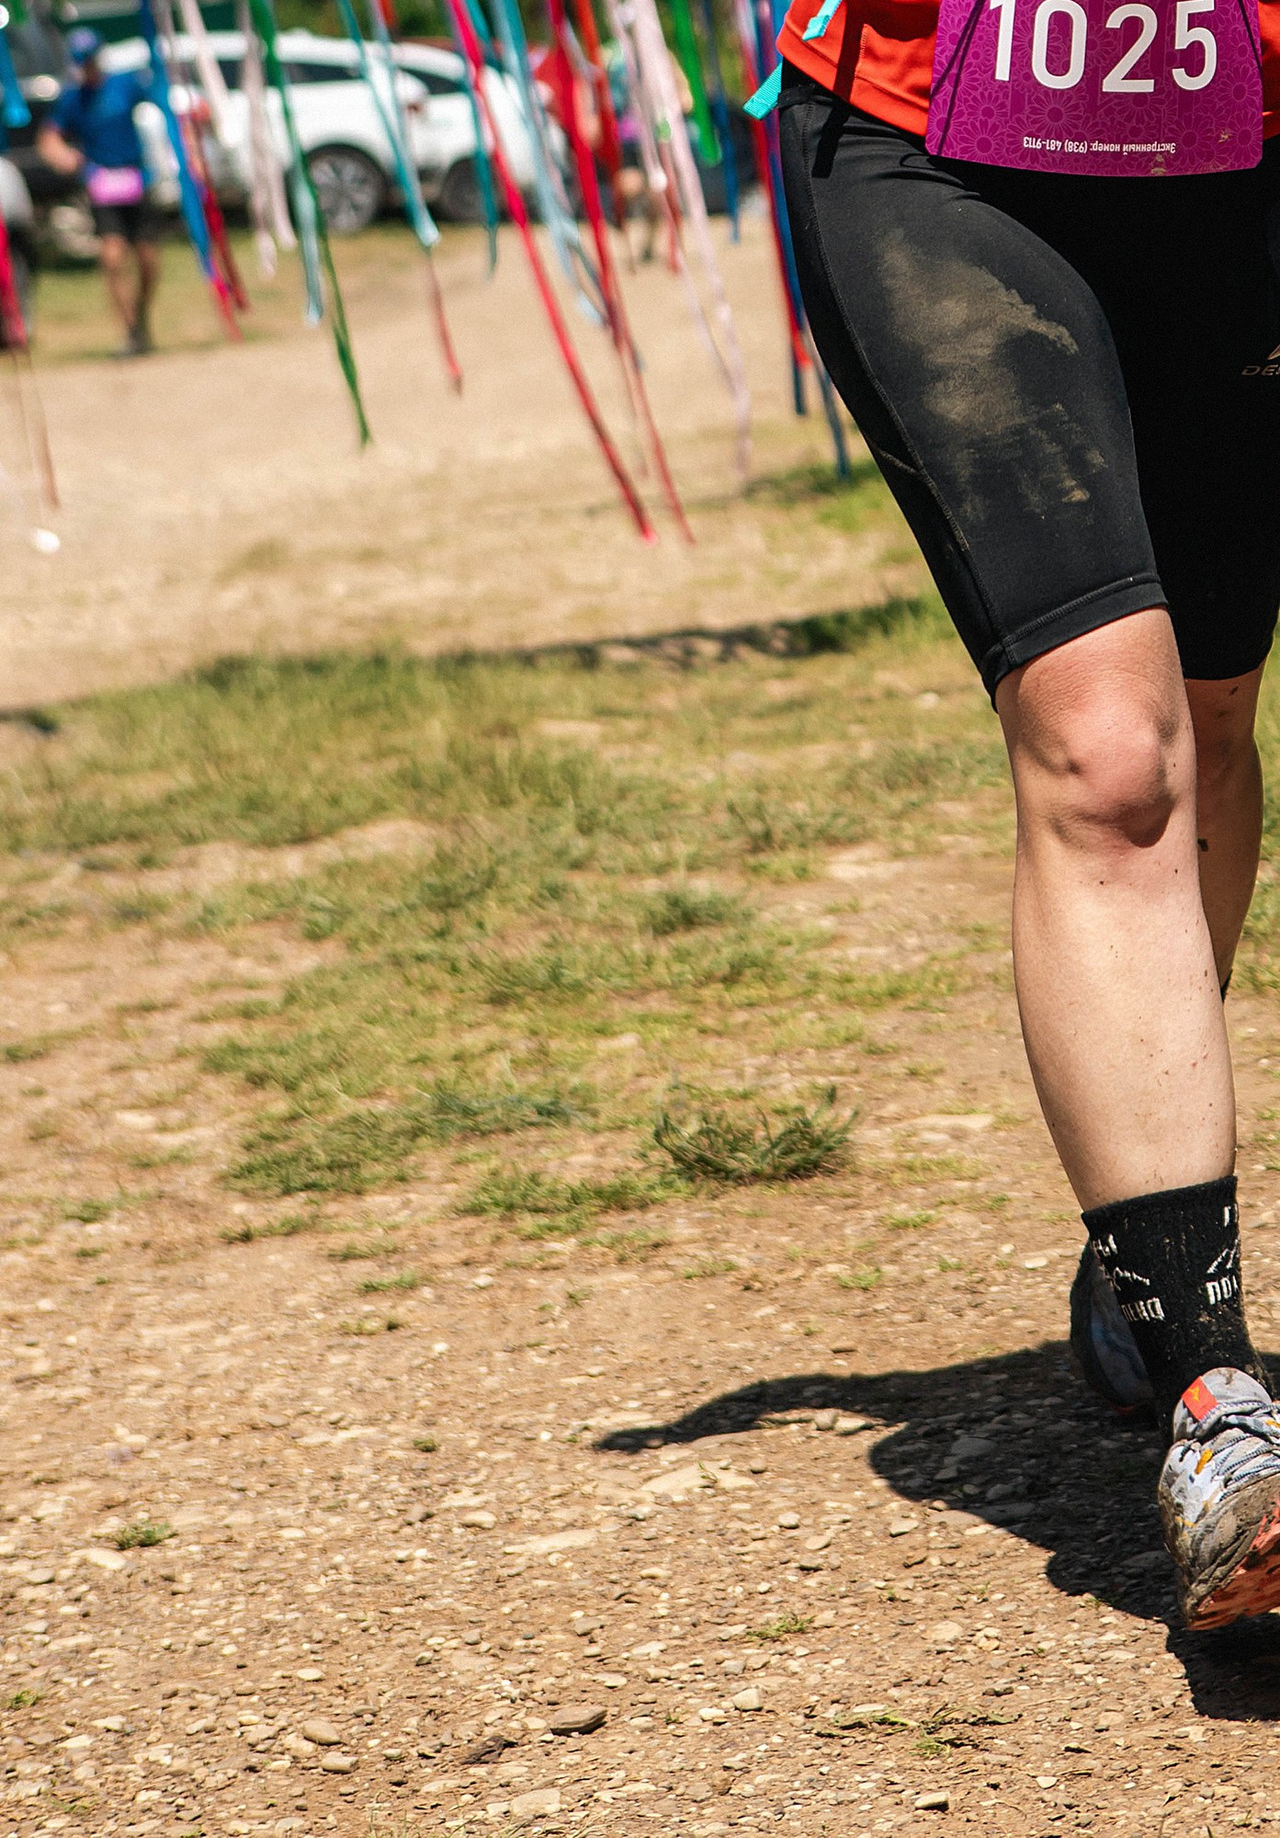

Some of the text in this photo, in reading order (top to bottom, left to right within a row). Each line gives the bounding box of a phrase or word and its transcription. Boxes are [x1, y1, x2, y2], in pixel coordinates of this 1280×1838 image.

[1023, 135, 1176, 155] Экстренный номер: (938) 481-9113
